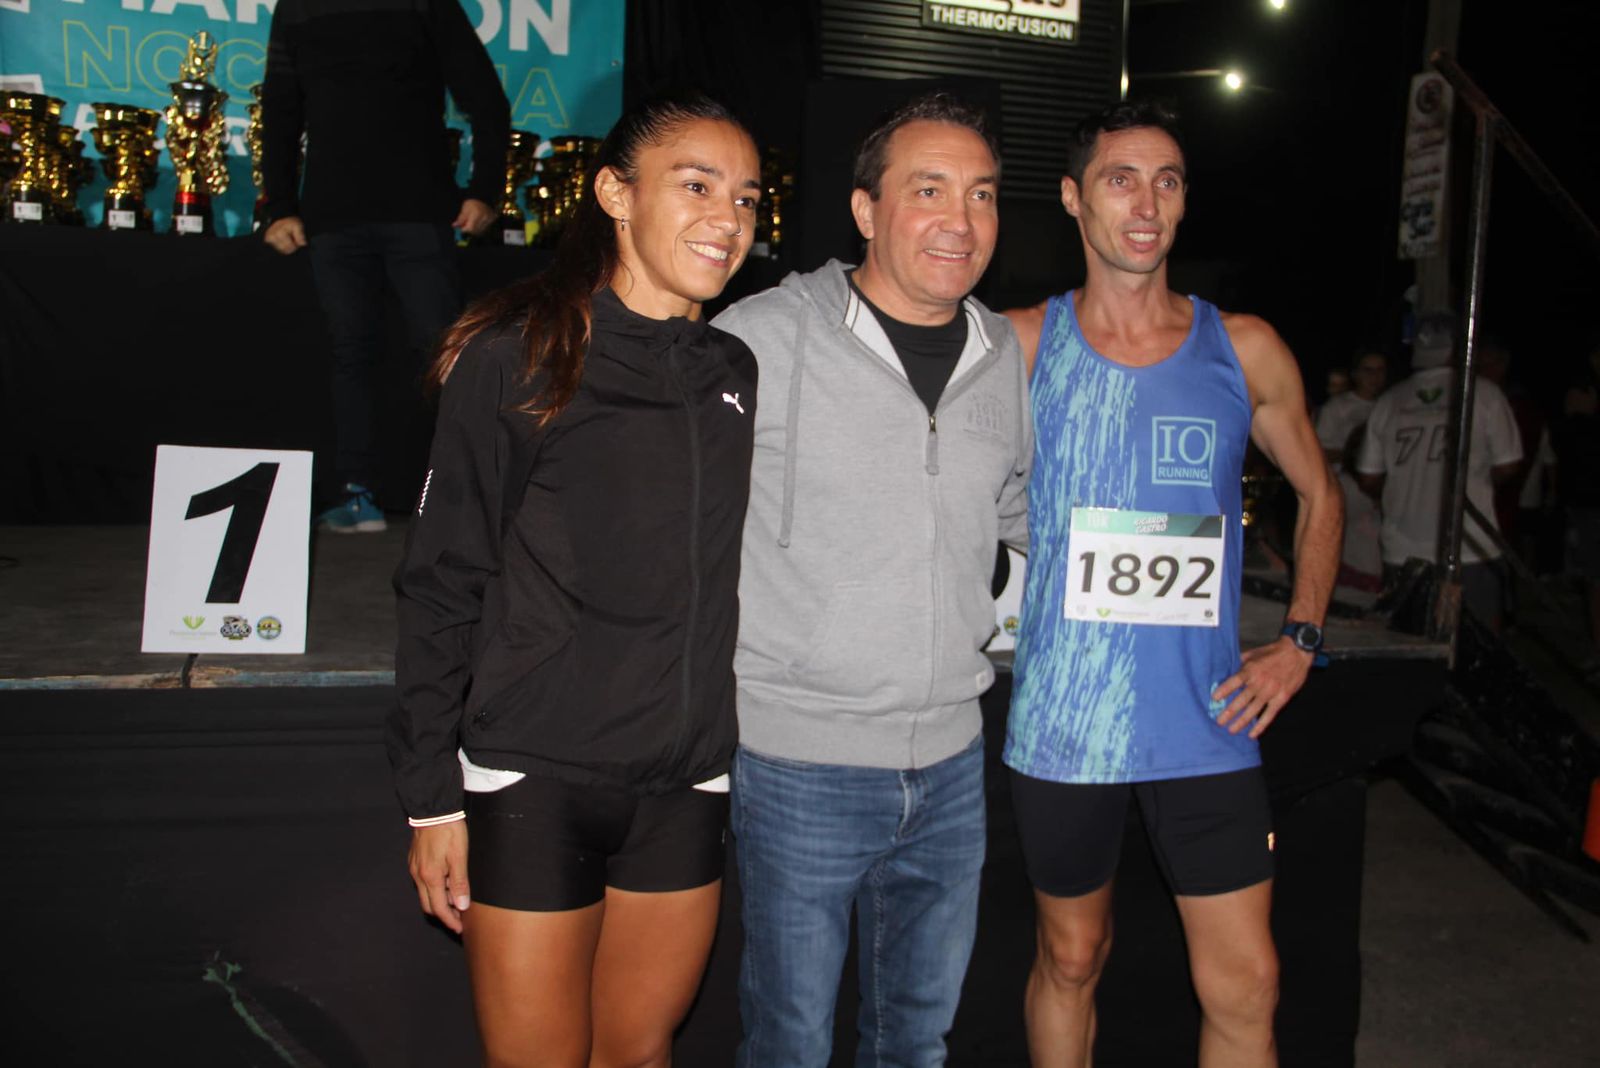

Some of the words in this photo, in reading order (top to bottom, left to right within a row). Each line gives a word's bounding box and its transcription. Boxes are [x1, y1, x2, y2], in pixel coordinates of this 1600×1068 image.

[930, 5, 1074, 39] THERMOFUSION
[1158, 425, 1212, 465] IO
[1158, 467, 1209, 480] RUNNING
[184, 462, 280, 604] 1
[1080, 551, 1216, 599] 1892
